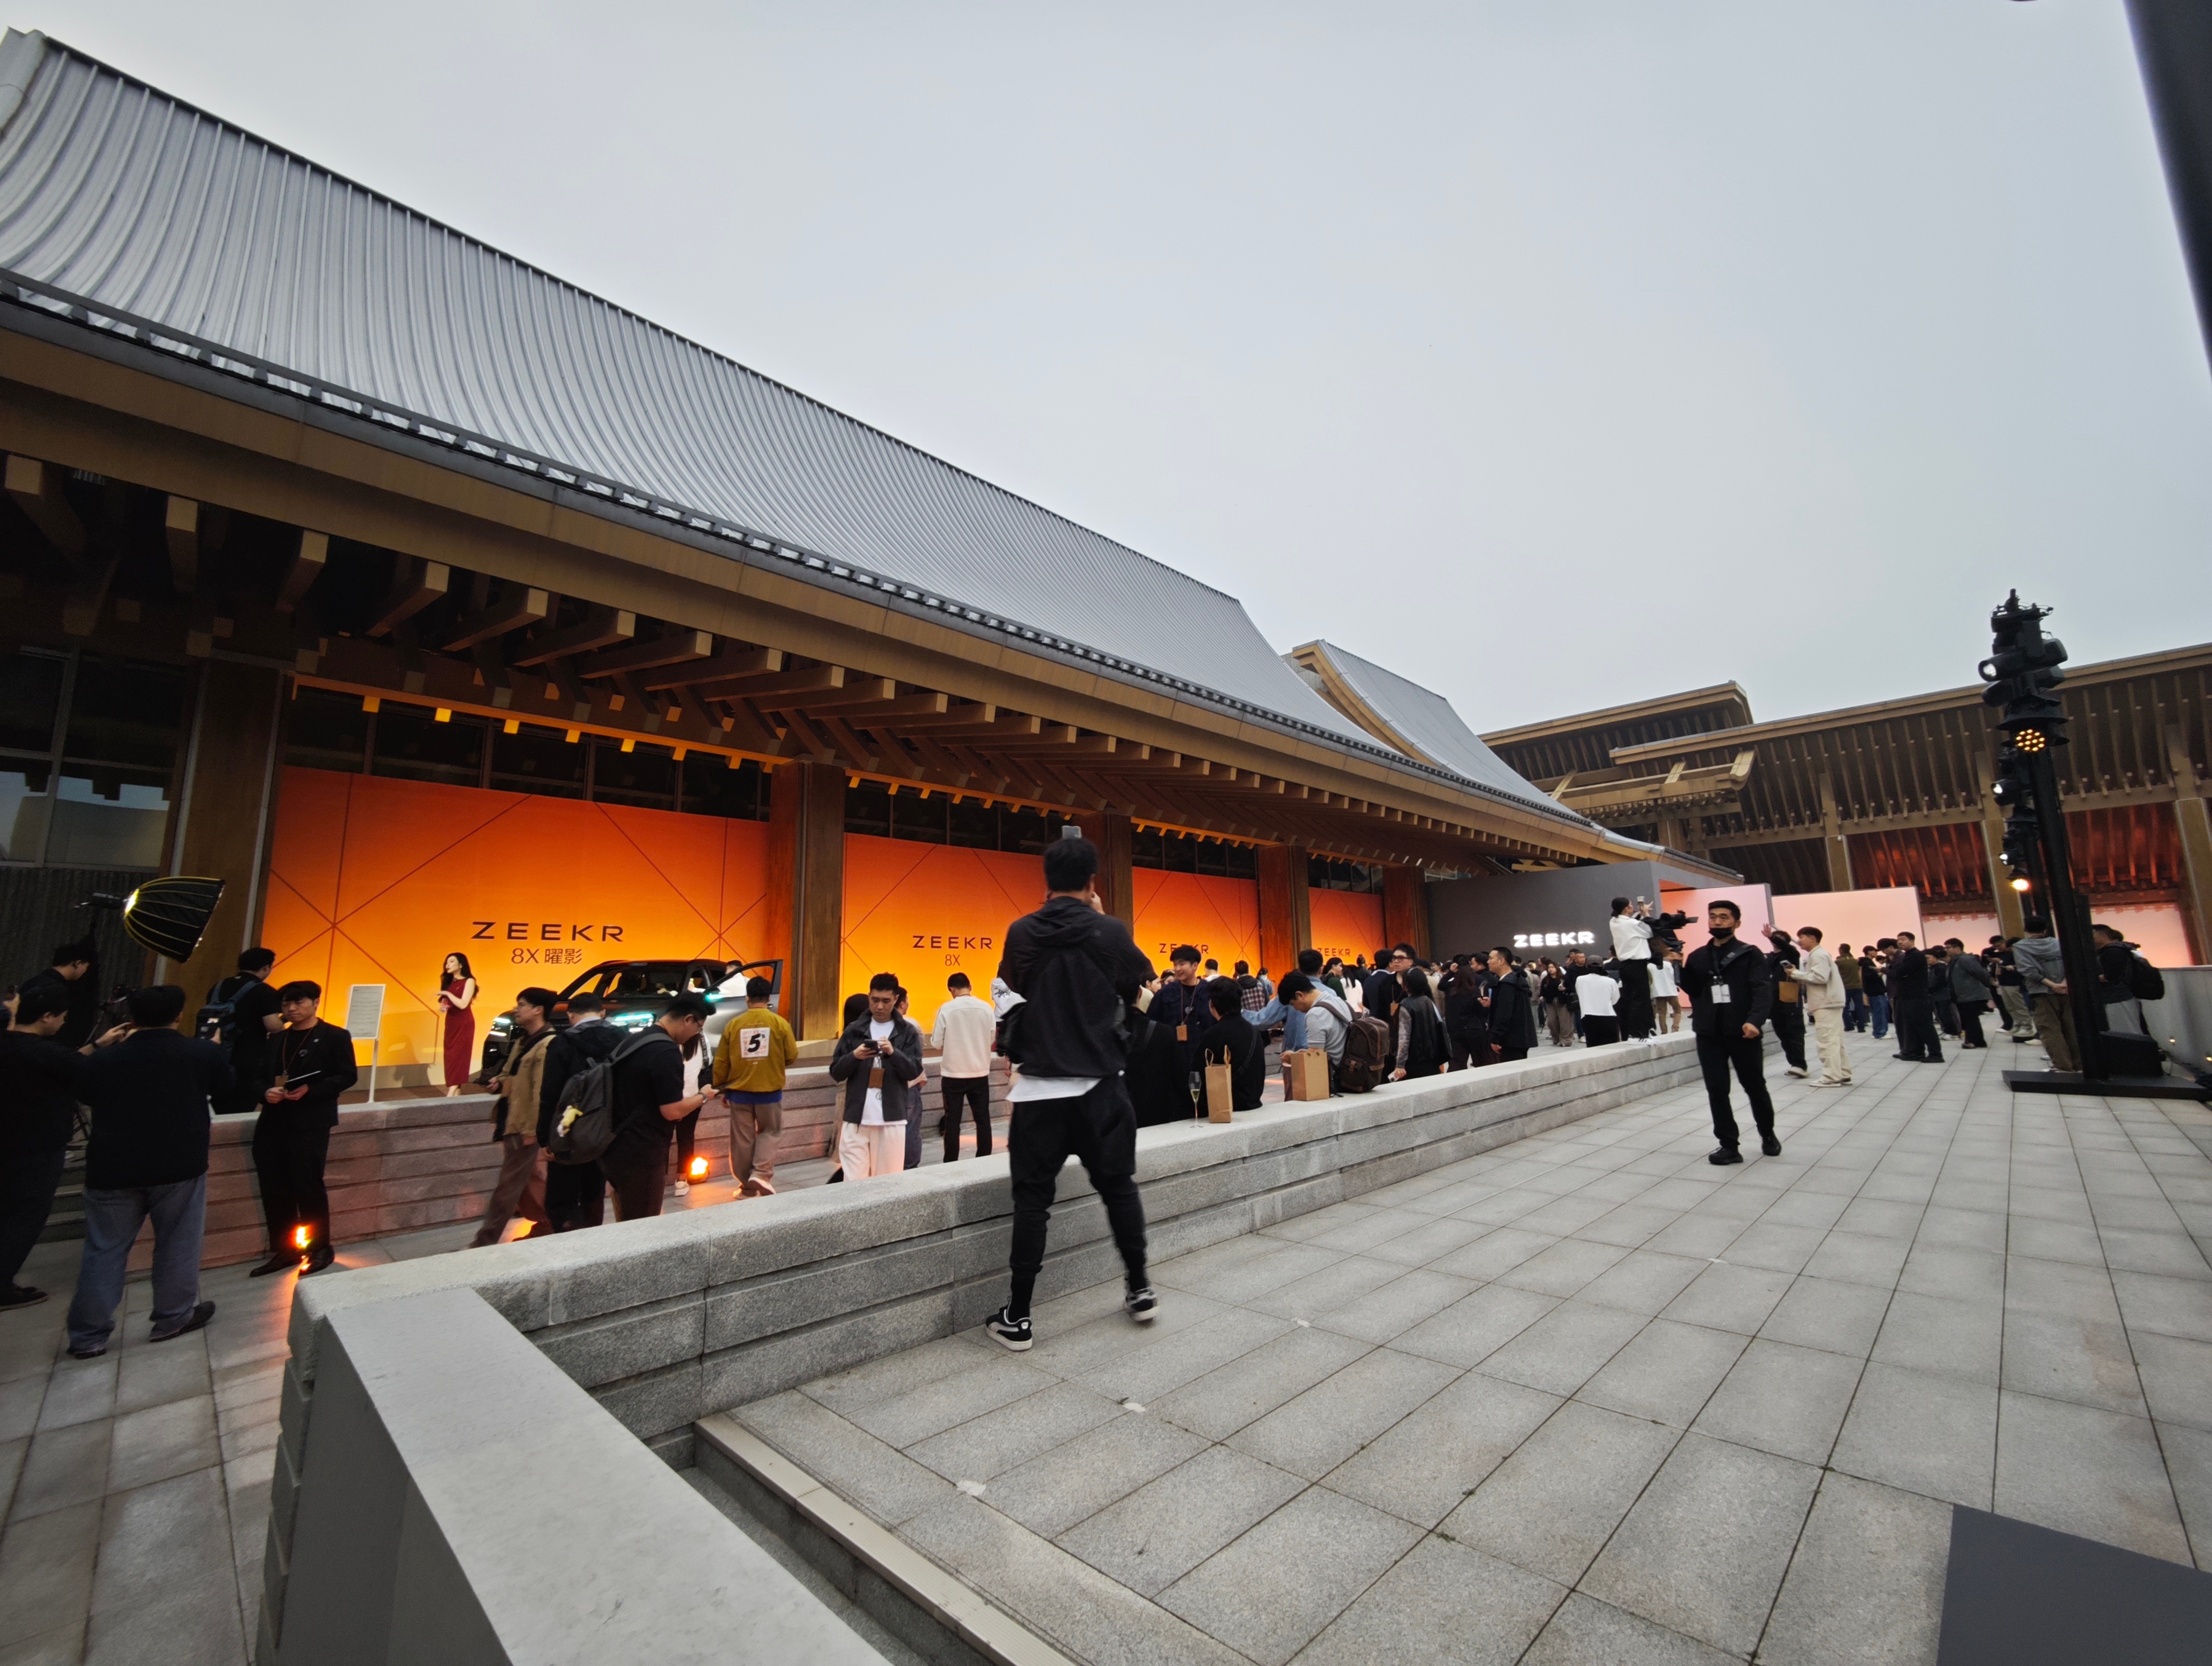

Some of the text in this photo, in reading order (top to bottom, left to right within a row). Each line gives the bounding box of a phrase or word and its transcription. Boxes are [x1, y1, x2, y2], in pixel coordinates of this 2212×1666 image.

[471, 921, 623, 941] ZEEKR
[1513, 931, 1595, 947] ZEEKR
[912, 935, 992, 949] ZEEKR
[1159, 943, 1208, 954] ZER
[511, 948, 582, 964] 8X 曜影
[945, 954, 960, 966] 8X
[748, 1033, 761, 1053] 5
